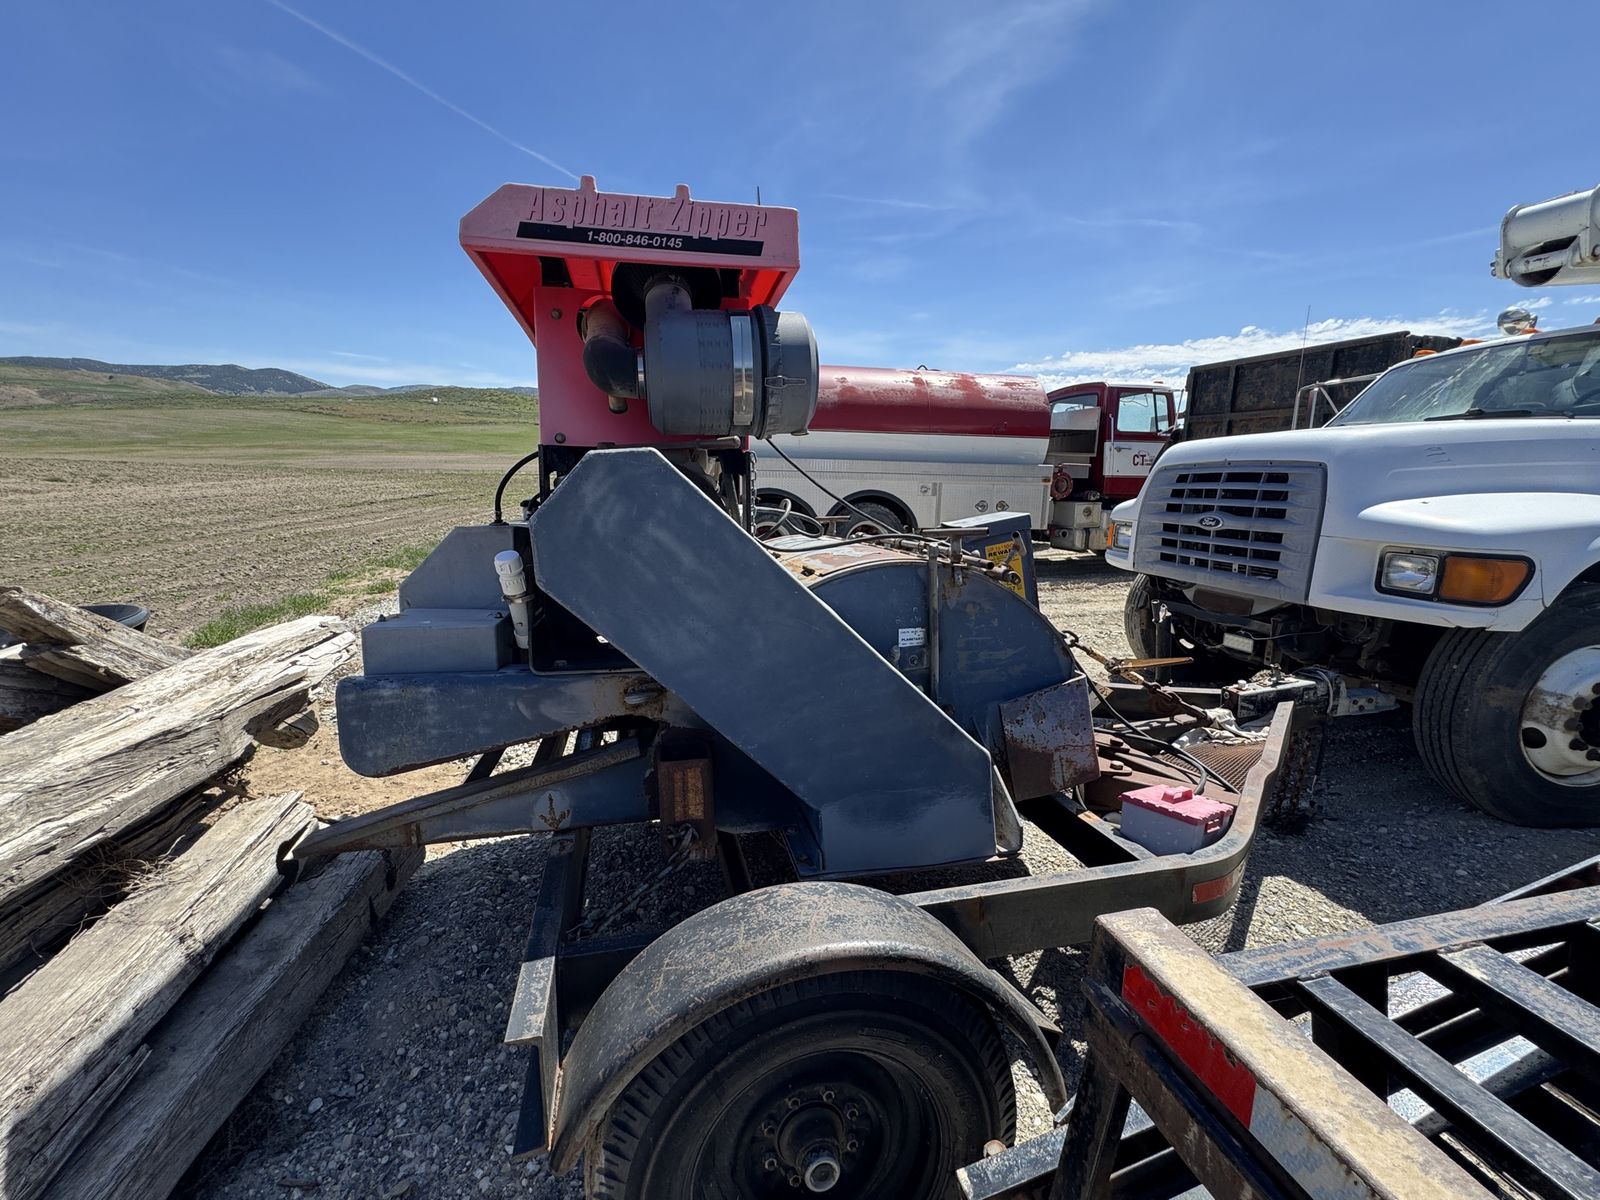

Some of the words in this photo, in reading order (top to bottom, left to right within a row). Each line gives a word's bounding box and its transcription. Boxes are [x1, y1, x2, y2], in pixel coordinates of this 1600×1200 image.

[526, 187, 655, 229] Asphalt
[664, 197, 768, 240] Zipper
[586, 231, 683, 249] 1-800-846-0145
[1201, 517, 1219, 527] Ford
[988, 548, 1011, 558] REWA
